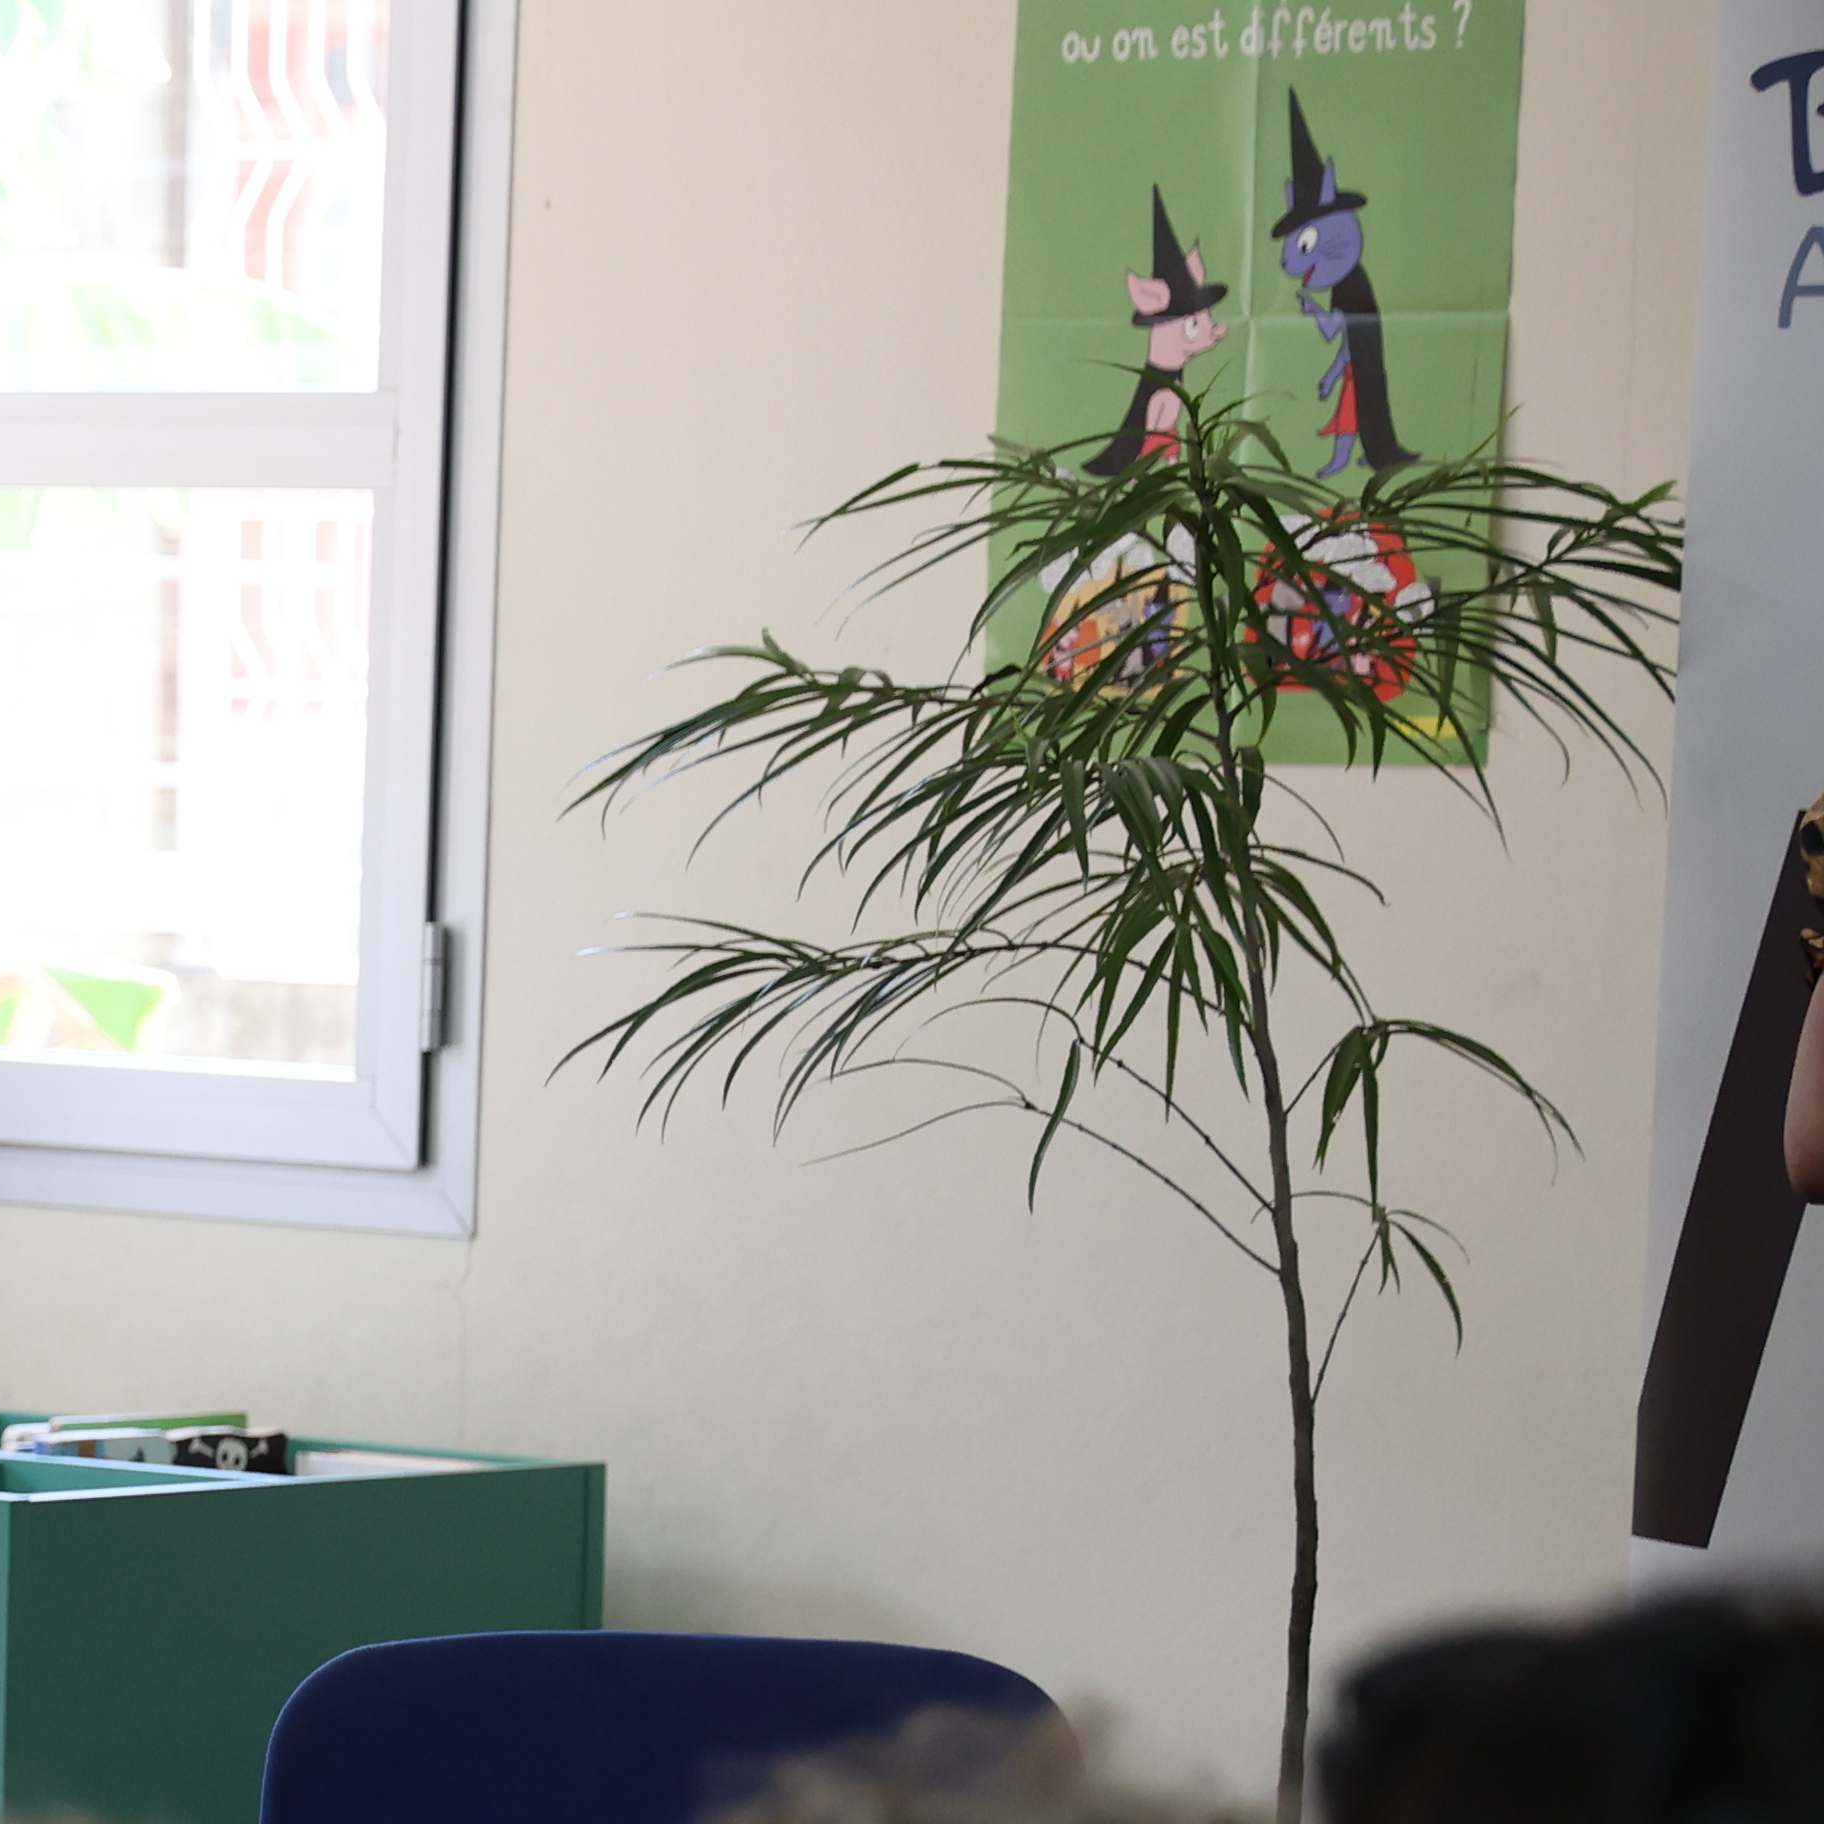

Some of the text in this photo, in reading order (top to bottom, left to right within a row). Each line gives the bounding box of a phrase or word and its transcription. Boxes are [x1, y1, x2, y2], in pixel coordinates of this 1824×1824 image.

[1061, 0, 1475, 64] ou on est différents ?
